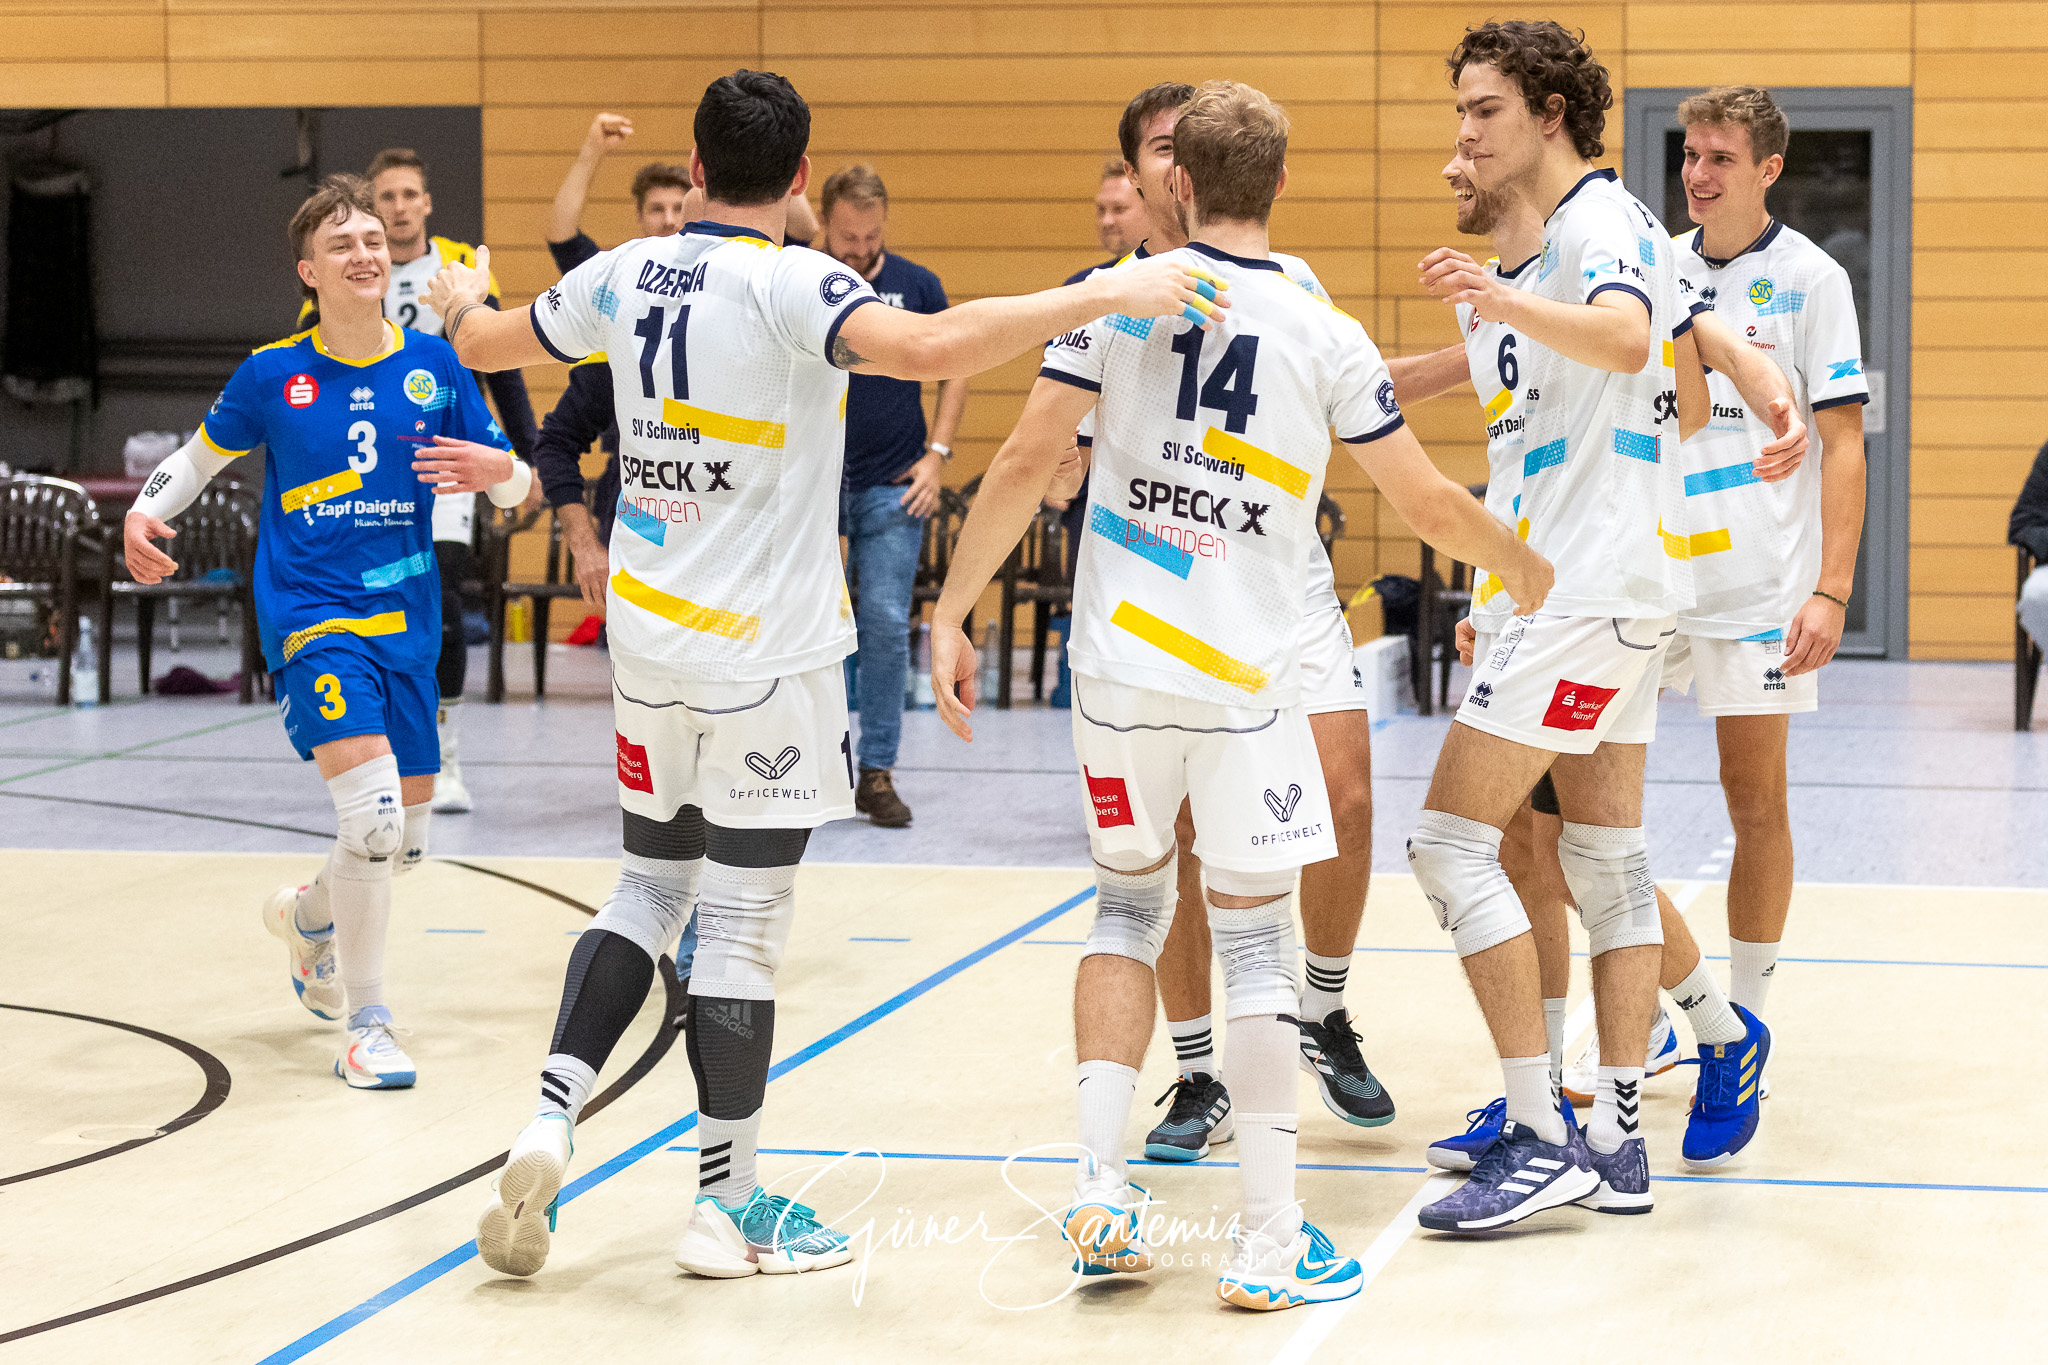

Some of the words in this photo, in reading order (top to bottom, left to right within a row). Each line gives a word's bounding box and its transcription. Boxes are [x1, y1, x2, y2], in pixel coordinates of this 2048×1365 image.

[634, 305, 692, 400] 11
[1497, 333, 1519, 391] 6
[1171, 322, 1259, 434] 14
[1712, 403, 1744, 419] fuss
[347, 420, 378, 474] 3
[632, 418, 644, 437] SV
[647, 420, 700, 445] Schwaig
[1162, 441, 1181, 461] SV
[622, 454, 697, 493] SPECK
[316, 500, 352, 518] Zapf
[354, 499, 415, 516] Daigfuss
[618, 495, 701, 528] pumpen
[1128, 477, 1232, 530] SPECK
[1124, 518, 1226, 562] pumpen
[314, 673, 347, 720] 3
[1468, 694, 1490, 709] errea
[1763, 682, 1786, 690] errea
[729, 787, 818, 800] OFFICEWELT
[1251, 823, 1323, 846] OFFICEWELT
[704, 1006, 756, 1040] adidas
